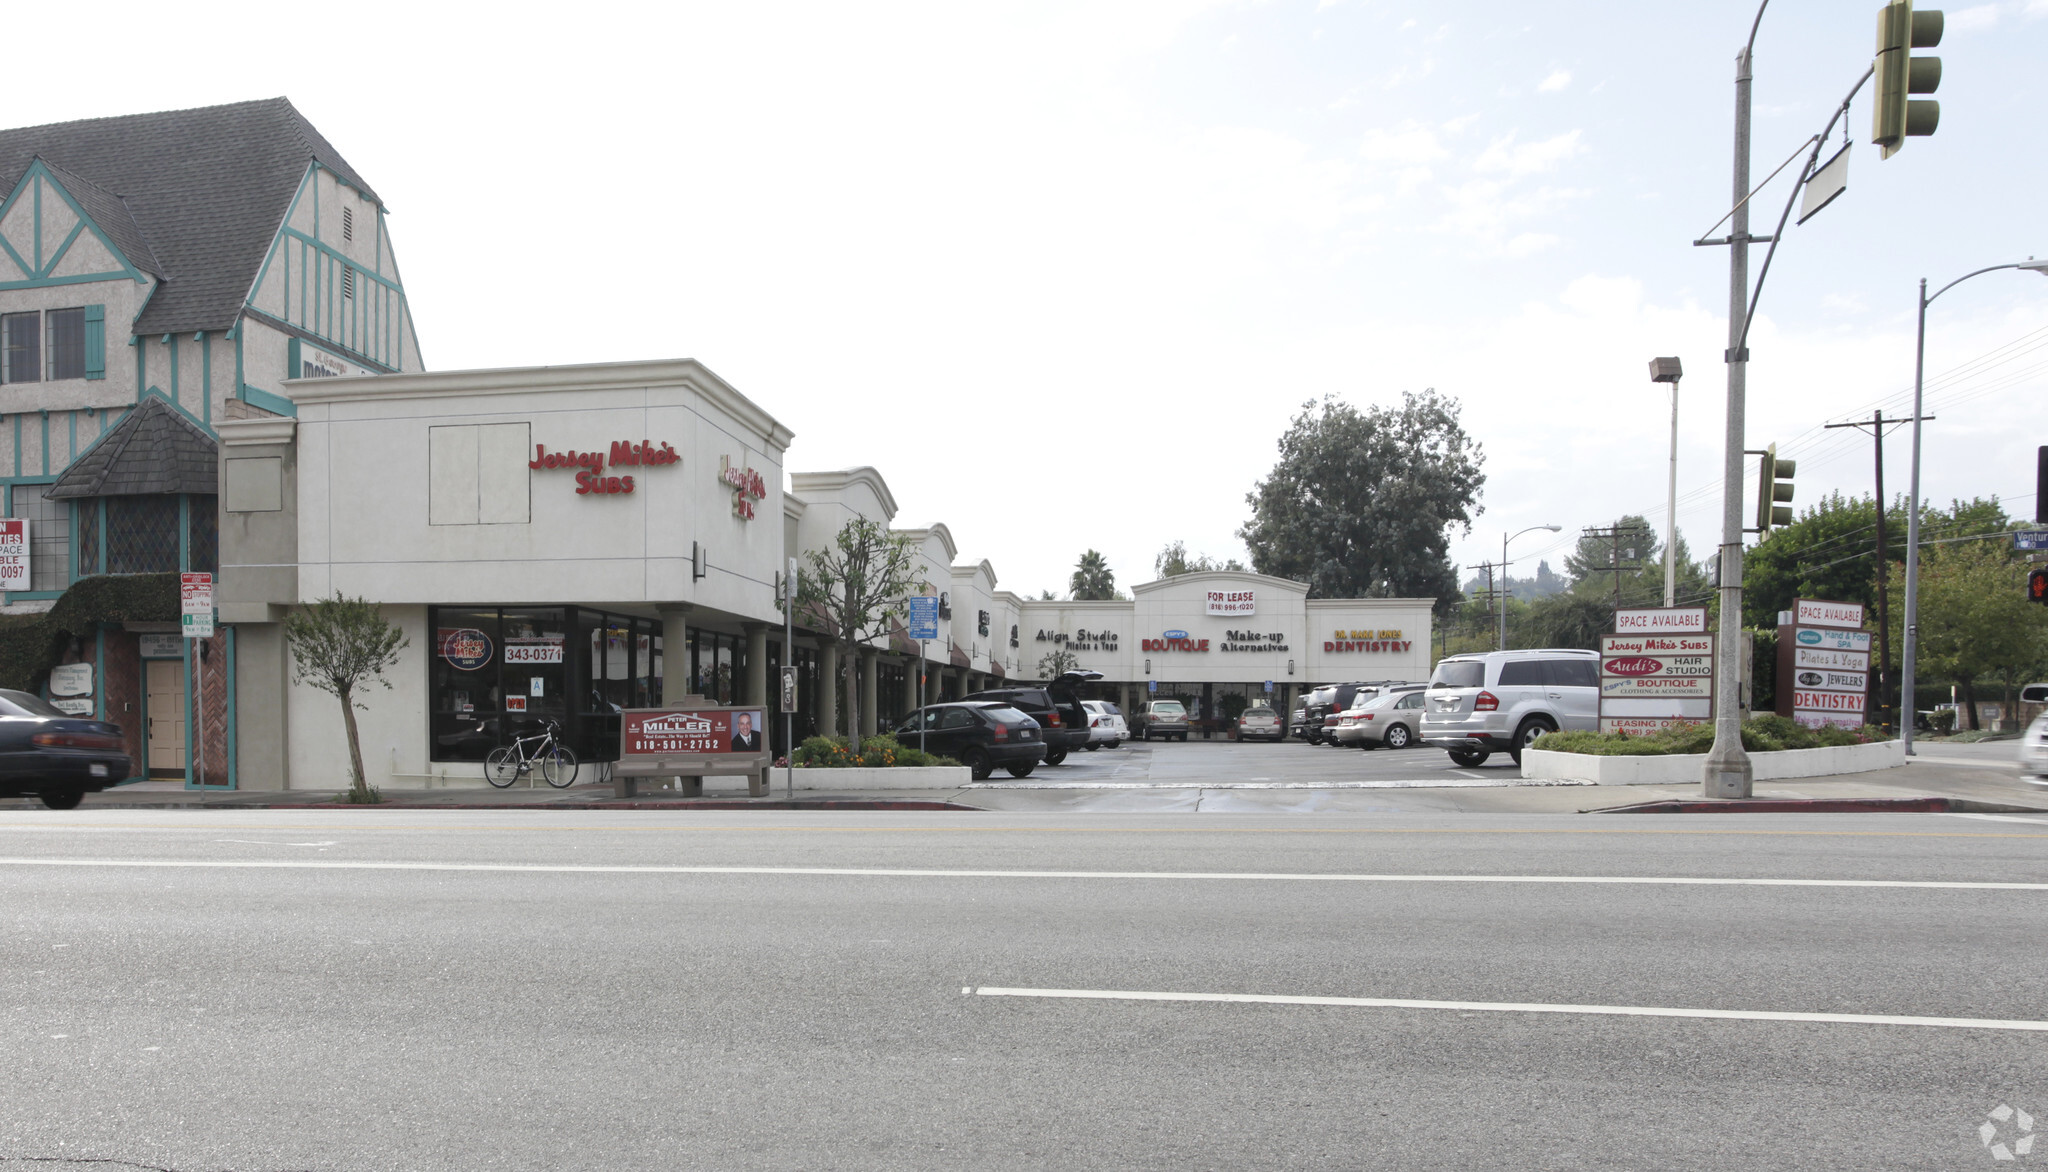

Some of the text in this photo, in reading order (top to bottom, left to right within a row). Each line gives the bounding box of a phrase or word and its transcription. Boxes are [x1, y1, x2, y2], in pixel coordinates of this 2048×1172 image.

[528, 440, 682, 474] Jersey Mike's
[183, 591, 192, 599] NO
[1208, 592, 1254, 602] FOR LEASE
[1620, 614, 1700, 627] SPACE AVAILABLE
[1800, 607, 1860, 622] SPACE AVAILABLE
[1036, 629, 1118, 643] Align Studio
[1226, 630, 1284, 643] Make-up
[1377, 630, 1402, 640] JONES
[1825, 630, 1843, 639] Hand
[1853, 632, 1868, 641] Foot
[454, 635, 484, 652] Jersey
[1142, 639, 1210, 652] BOUTIQUE
[1220, 642, 1289, 652] Alternatives
[1324, 641, 1412, 652] DENTISTRY
[1608, 640, 1642, 653] Jersey
[1645, 639, 1678, 650] Mike's
[507, 648, 561, 660] 343-0371
[1801, 650, 1863, 668] Pilates & Yoga
[1611, 659, 1657, 671] Audi's
[534, 681, 541, 690] A
[1604, 680, 1632, 691] ESPY'S
[1826, 673, 1863, 687] JEWELERS
[1795, 693, 1864, 709] DENTISTRY
[644, 722, 711, 733] MILLER
[636, 740, 719, 749] 818-501-2752
